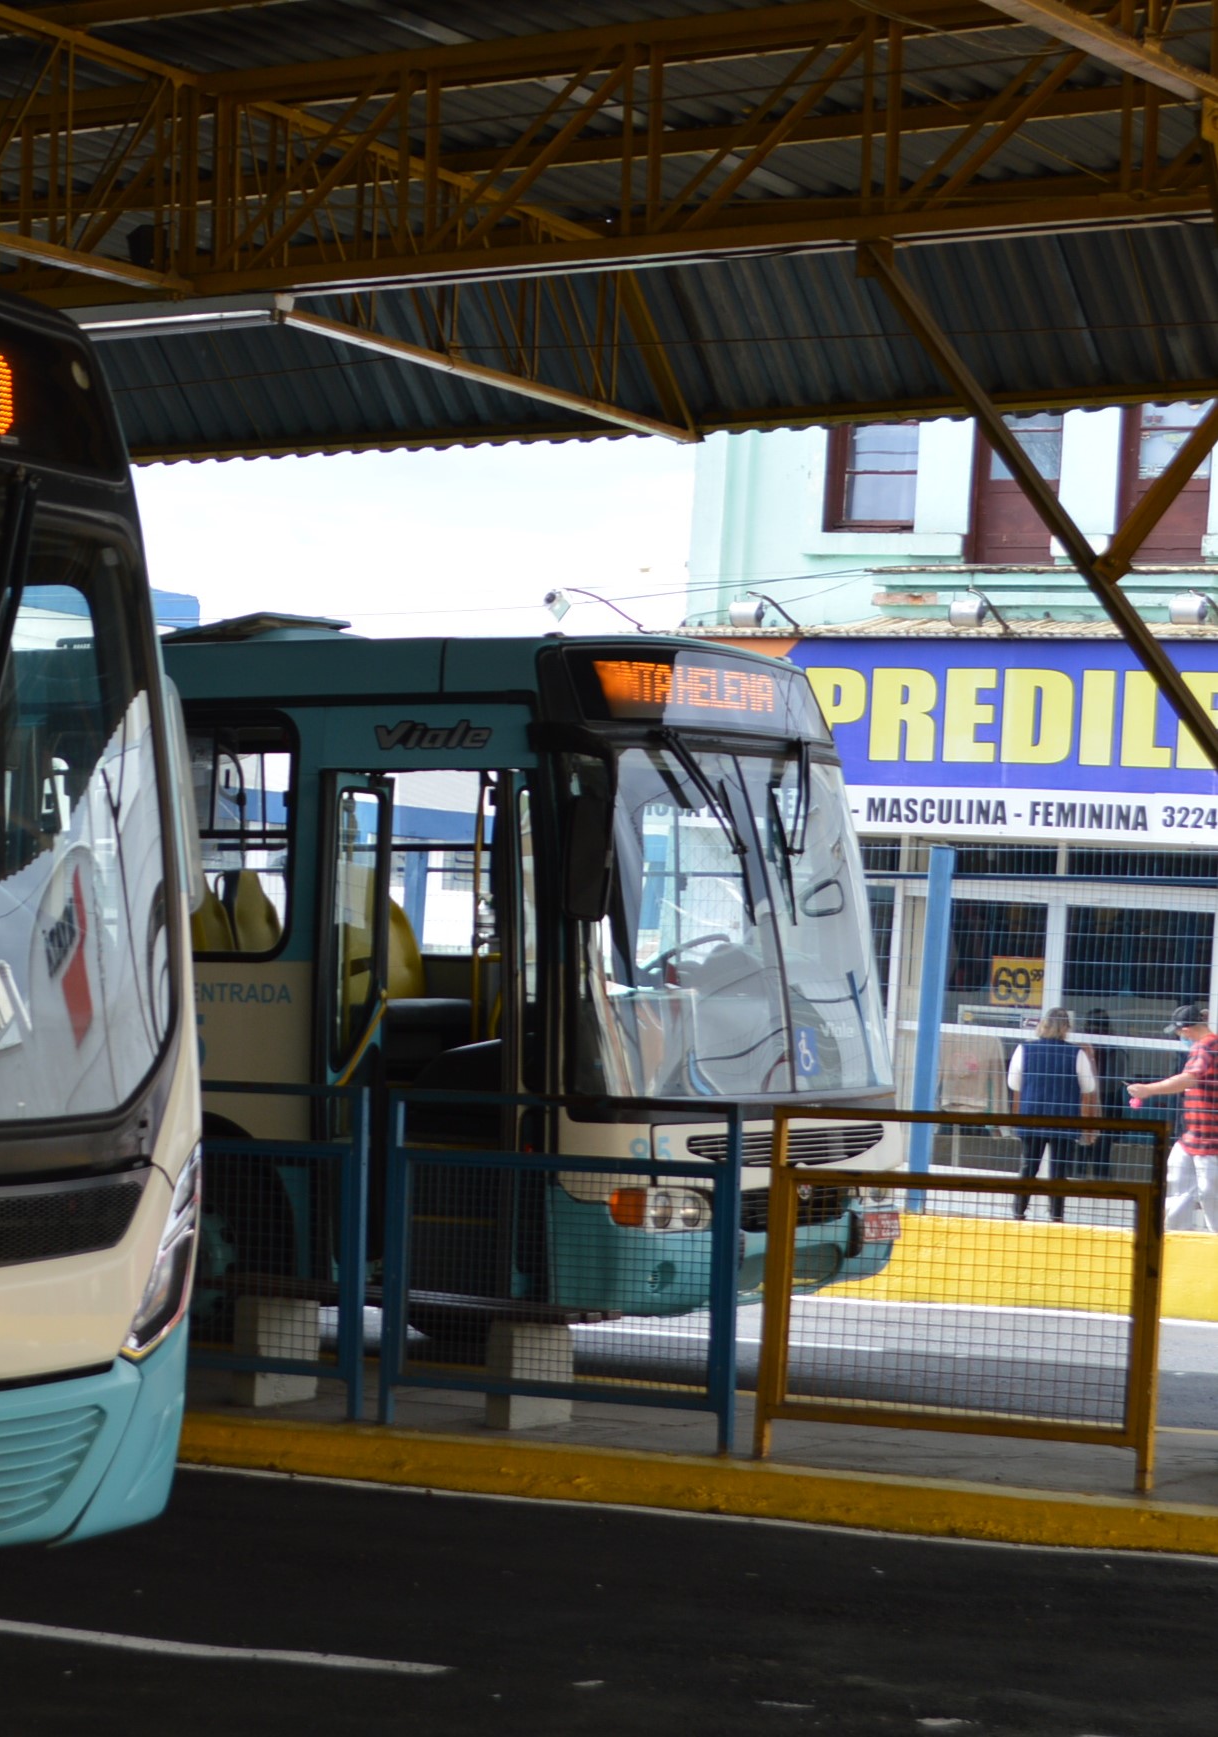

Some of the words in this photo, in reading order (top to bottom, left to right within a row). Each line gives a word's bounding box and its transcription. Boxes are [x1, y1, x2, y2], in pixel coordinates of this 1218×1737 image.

[593, 661, 673, 703] NTA
[676, 666, 774, 712] HELENA
[374, 719, 492, 750] Viale
[866, 797, 1007, 825] MASCULINA
[1028, 801, 1148, 831] FEMININA
[1162, 805, 1218, 829] 3224
[994, 966, 1031, 1003] 69
